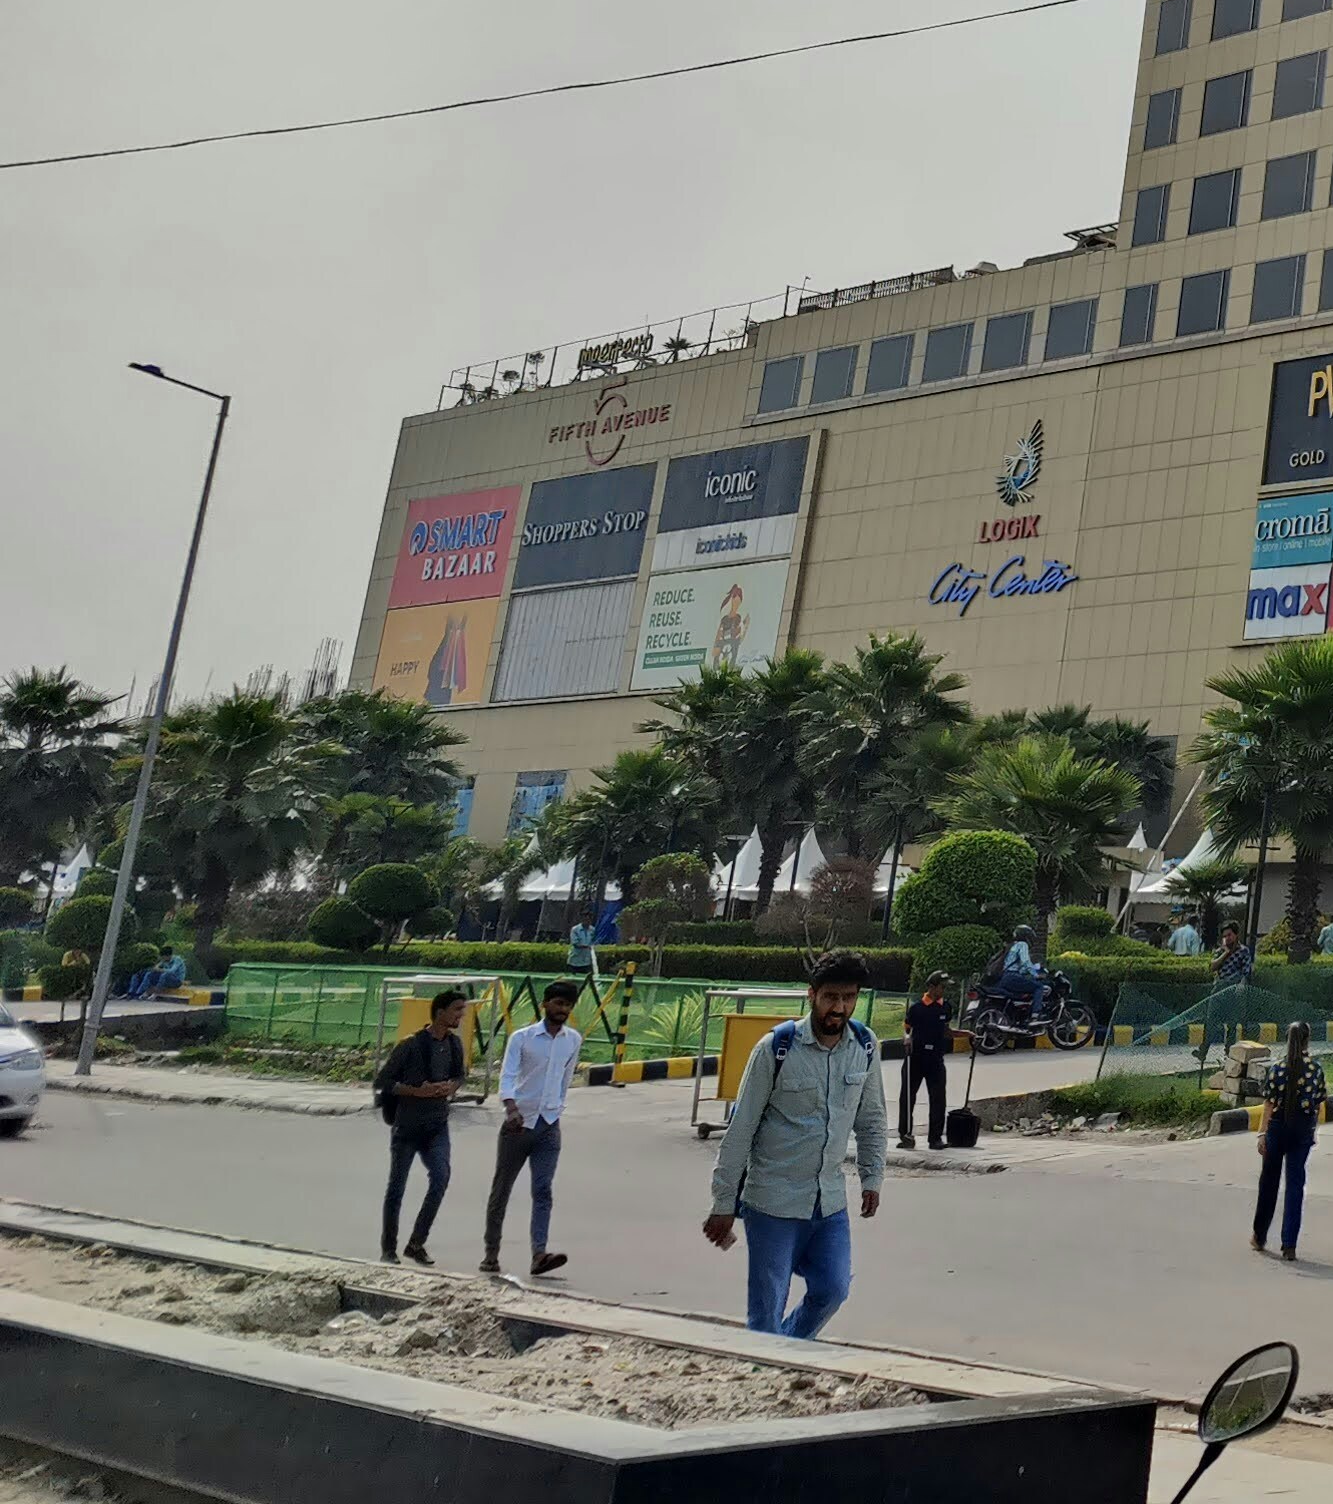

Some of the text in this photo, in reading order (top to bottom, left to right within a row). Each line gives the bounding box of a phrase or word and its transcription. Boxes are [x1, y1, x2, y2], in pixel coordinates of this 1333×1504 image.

[549, 404, 671, 444] FIFTH AVENUE
[1289, 449, 1325, 468] GOLD
[705, 465, 757, 498] iconic
[427, 509, 506, 554] SMART
[978, 514, 1040, 543] LOGIX
[421, 551, 497, 581] BAZAAR
[928, 555, 1079, 617] City Center
[1246, 581, 1328, 620] max
[390, 660, 420, 676] HAPPY
